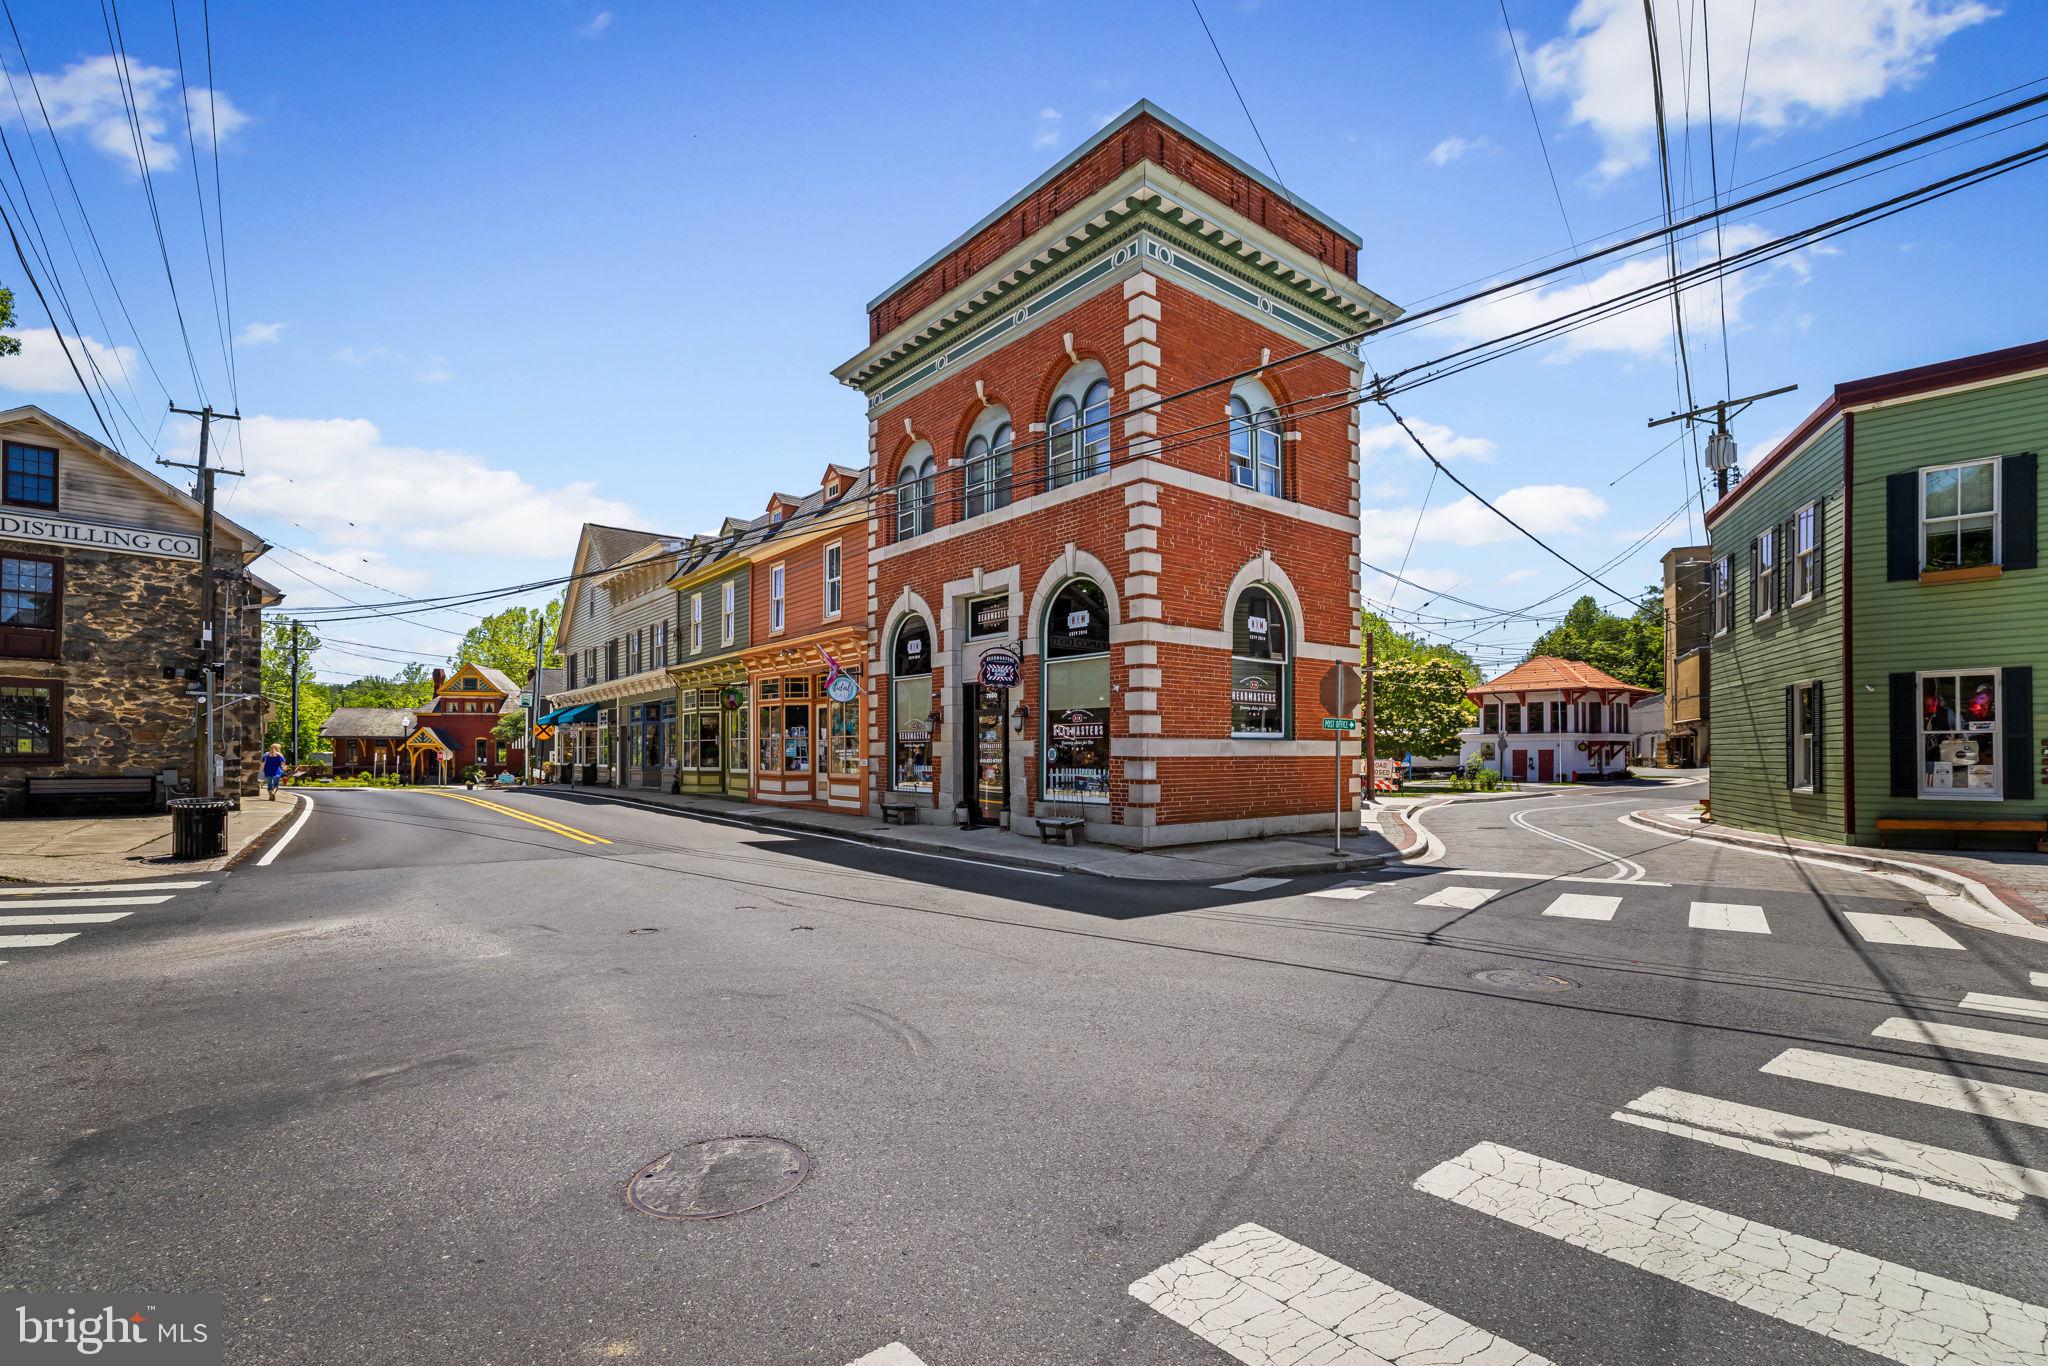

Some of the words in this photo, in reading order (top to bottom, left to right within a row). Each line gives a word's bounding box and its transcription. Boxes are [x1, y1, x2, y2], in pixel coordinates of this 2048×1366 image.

[0, 518, 151, 549] DISTILLING
[158, 538, 195, 555] CO.
[1232, 691, 1276, 703] HEADMASTERS
[1324, 719, 1335, 728] POST
[1335, 719, 1349, 728] OFFICE
[1053, 725, 1104, 737] HEADMASTERS
